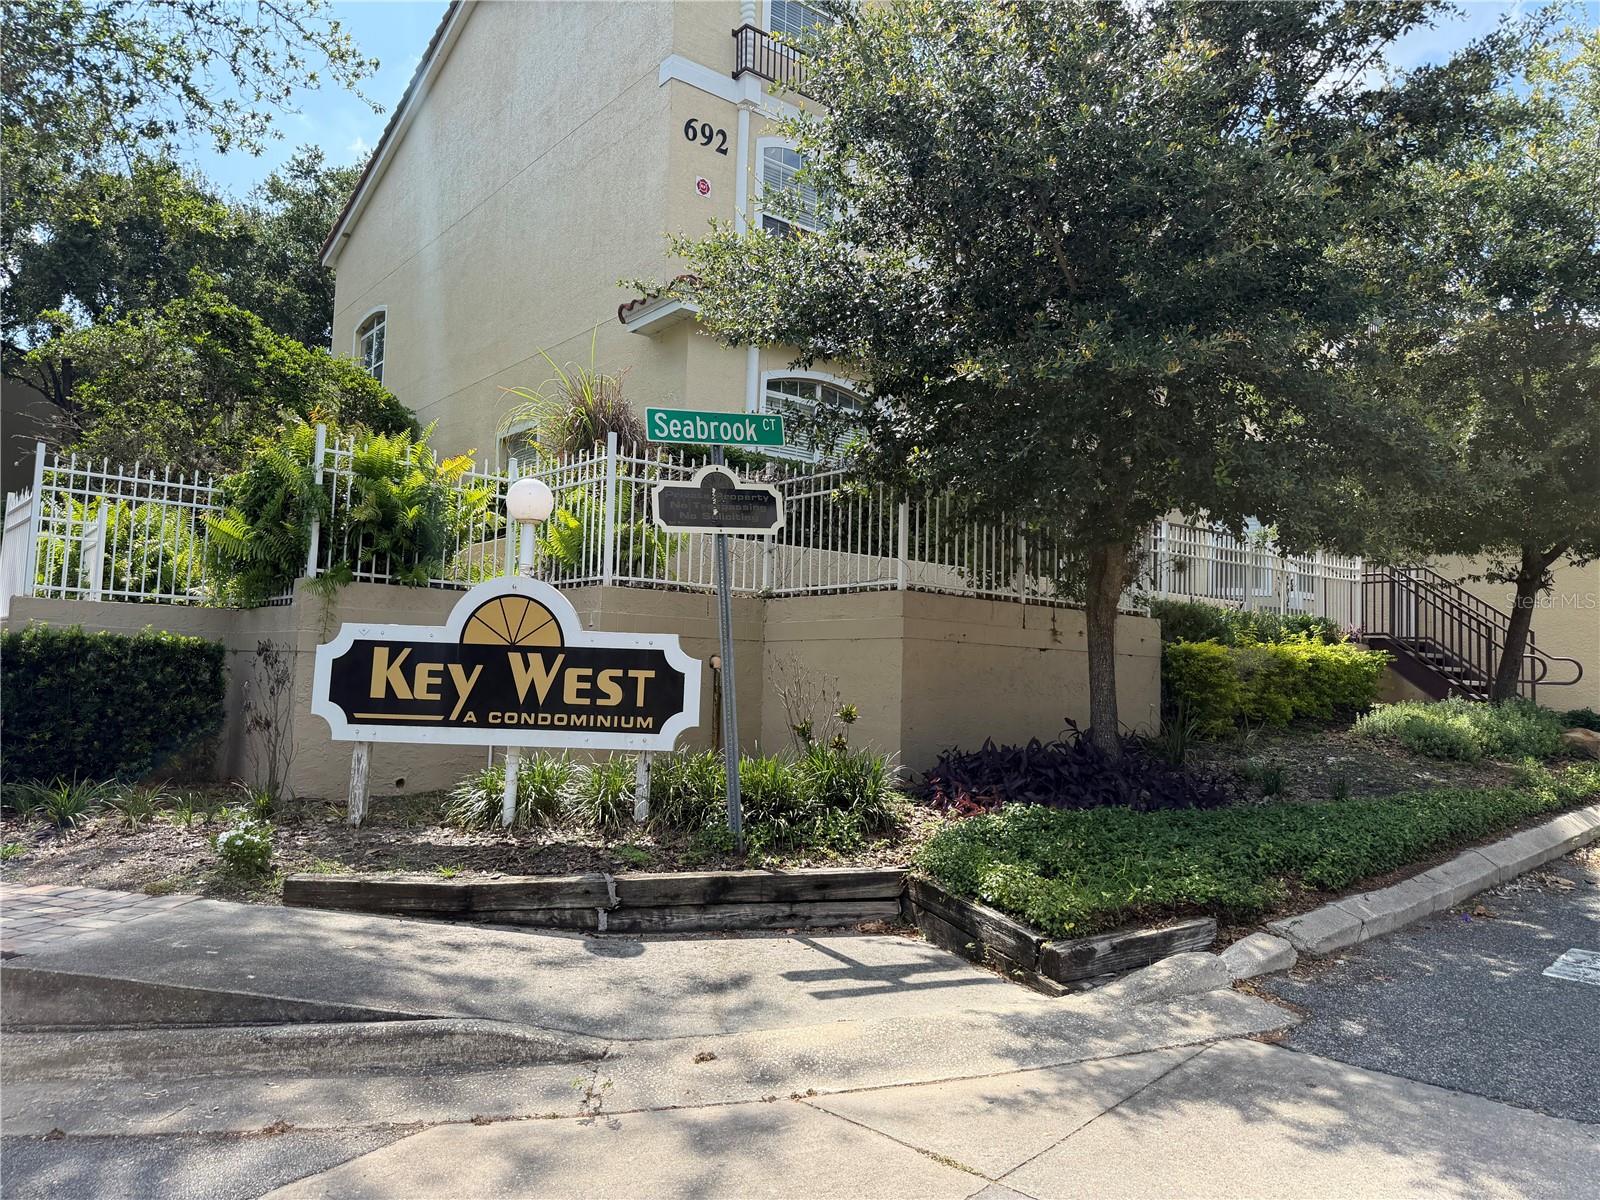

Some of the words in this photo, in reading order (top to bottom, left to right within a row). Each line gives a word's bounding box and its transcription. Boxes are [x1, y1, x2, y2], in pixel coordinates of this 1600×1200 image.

[684, 118, 728, 156] 692
[654, 412, 758, 442] Seabrook
[762, 418, 776, 431] CT
[670, 501, 689, 509] No
[679, 511, 697, 520] No
[369, 646, 483, 721] KEY
[507, 652, 656, 708] WEST
[462, 710, 478, 724] A
[488, 711, 654, 730] CONDOMINIUM
